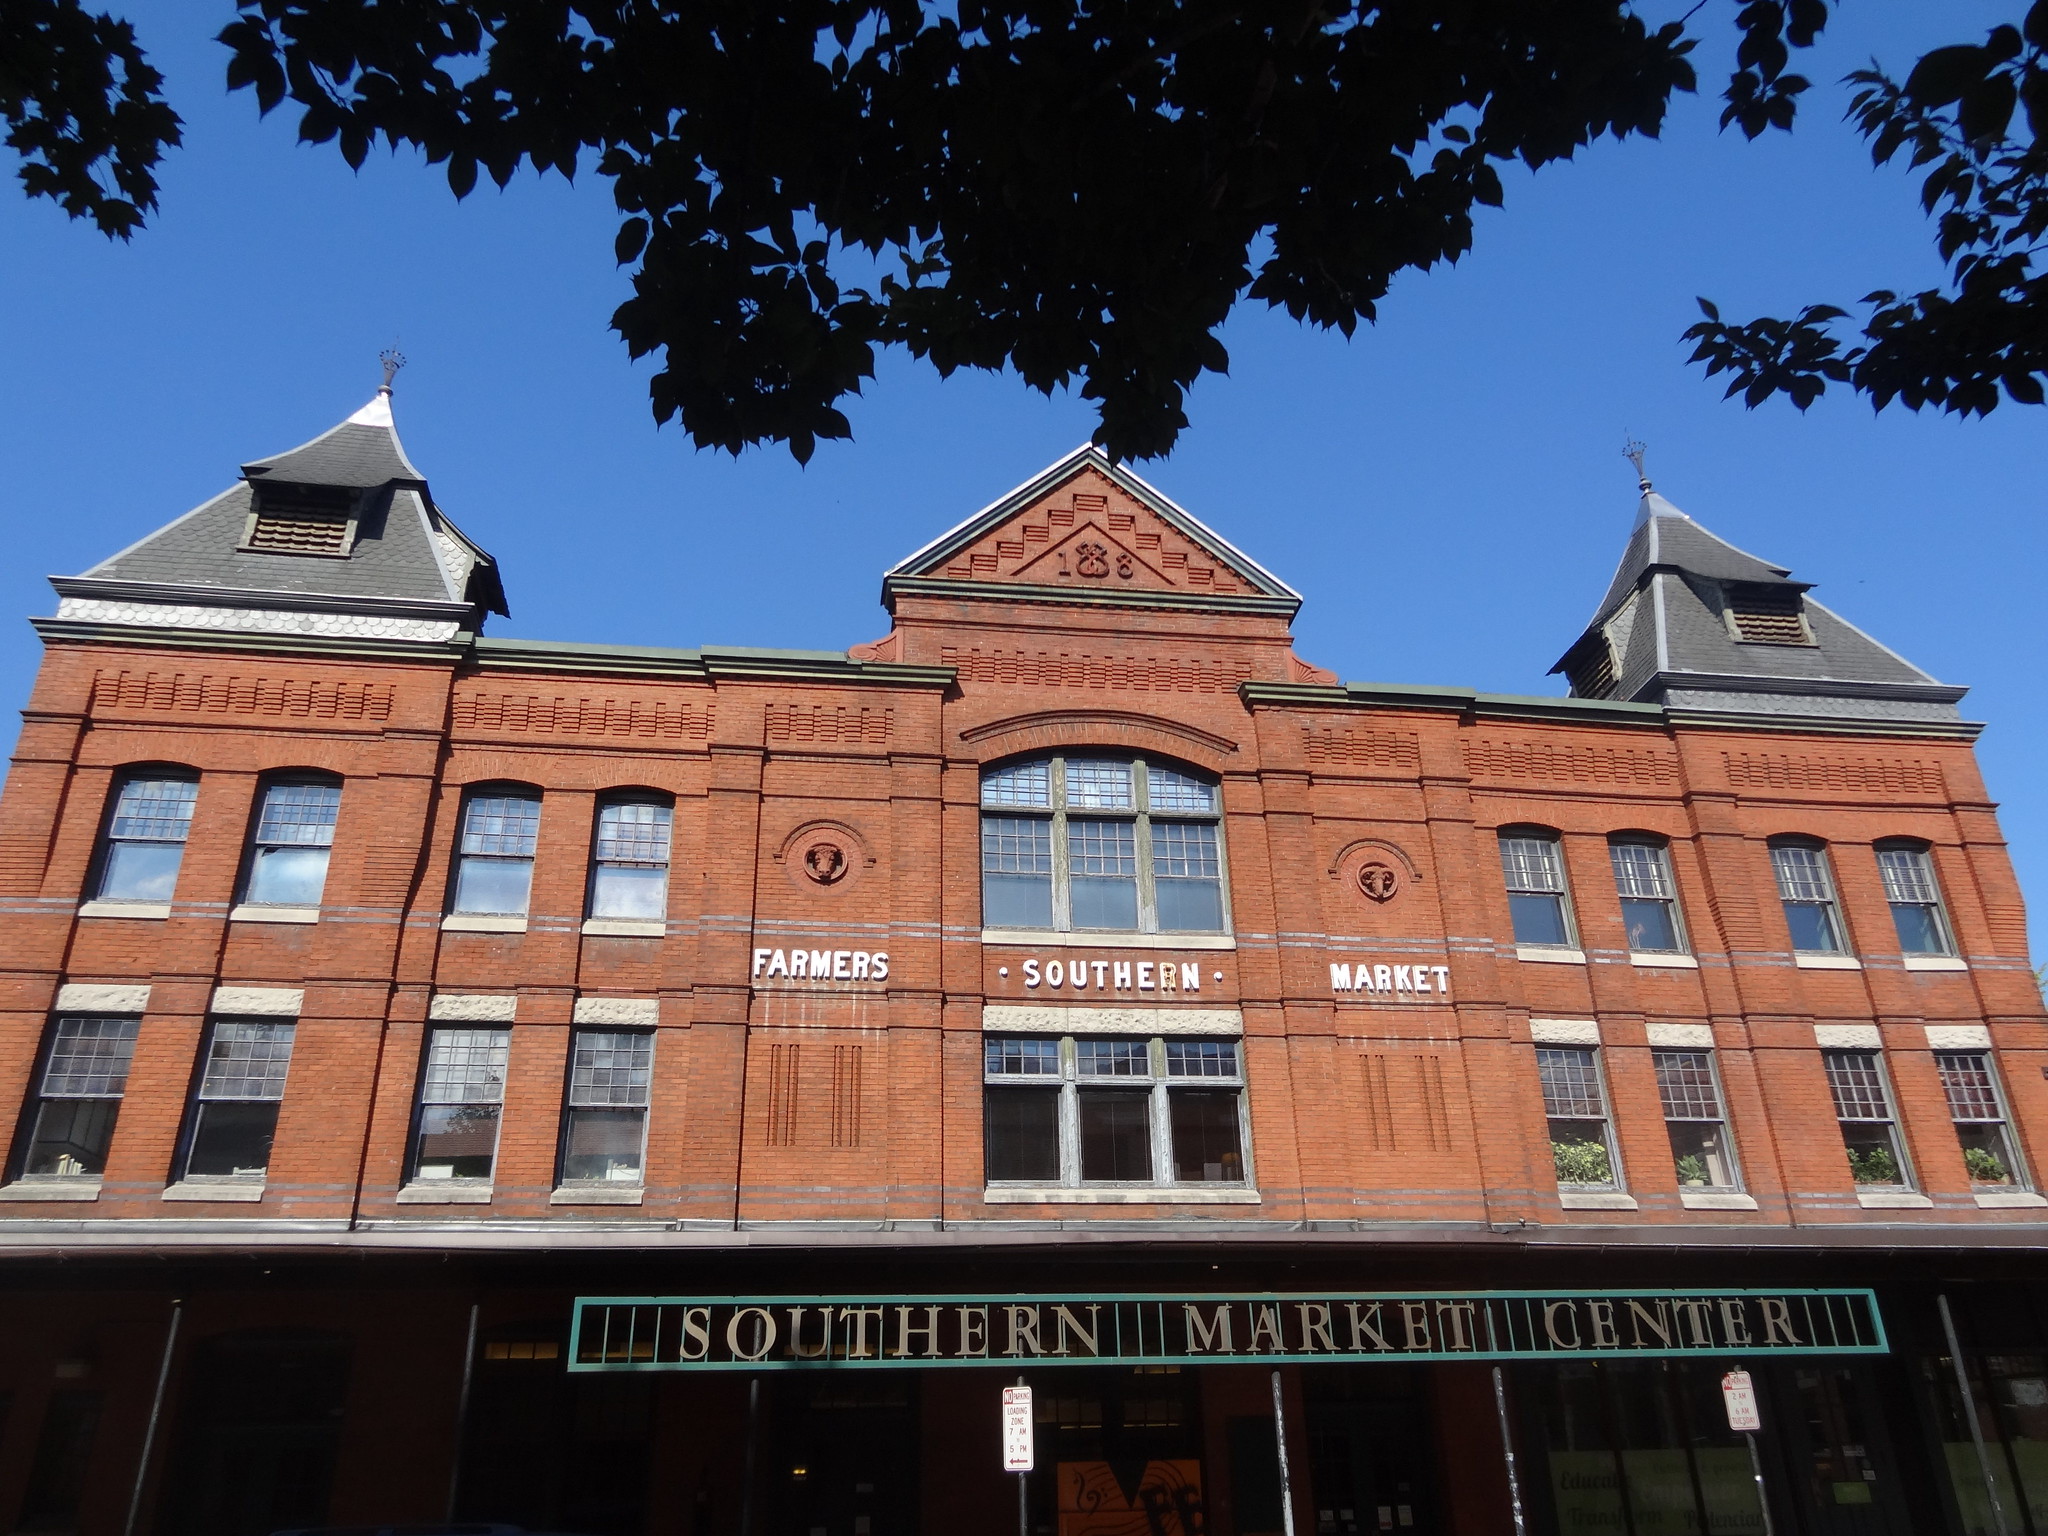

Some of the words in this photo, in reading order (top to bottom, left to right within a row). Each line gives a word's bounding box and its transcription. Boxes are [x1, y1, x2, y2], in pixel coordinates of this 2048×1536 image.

[754, 948, 889, 982] FARMERS
[1023, 958, 1200, 992] SOUTHERN
[1329, 963, 1449, 995] MARKET
[679, 1305, 1102, 1360] SOUTHERN
[1182, 1303, 1475, 1353] MARKET
[1544, 1299, 1804, 1349] CENTER
[1004, 1390, 1013, 1404] NO
[1013, 1392, 1030, 1400] PARKING
[1738, 1392, 1747, 1400] AM
[1007, 1406, 1028, 1416] LOADING
[1741, 1407, 1750, 1415] AM
[1010, 1417, 1025, 1426] ZONE
[1732, 1417, 1755, 1425] TUESDAY
[1009, 1428, 1014, 1436] 7
[1018, 1427, 1027, 1436] AM
[1009, 1446, 1015, 1454] 5
[1019, 1445, 1027, 1453] PM
[1568, 1506, 1663, 1530] Transfrm
